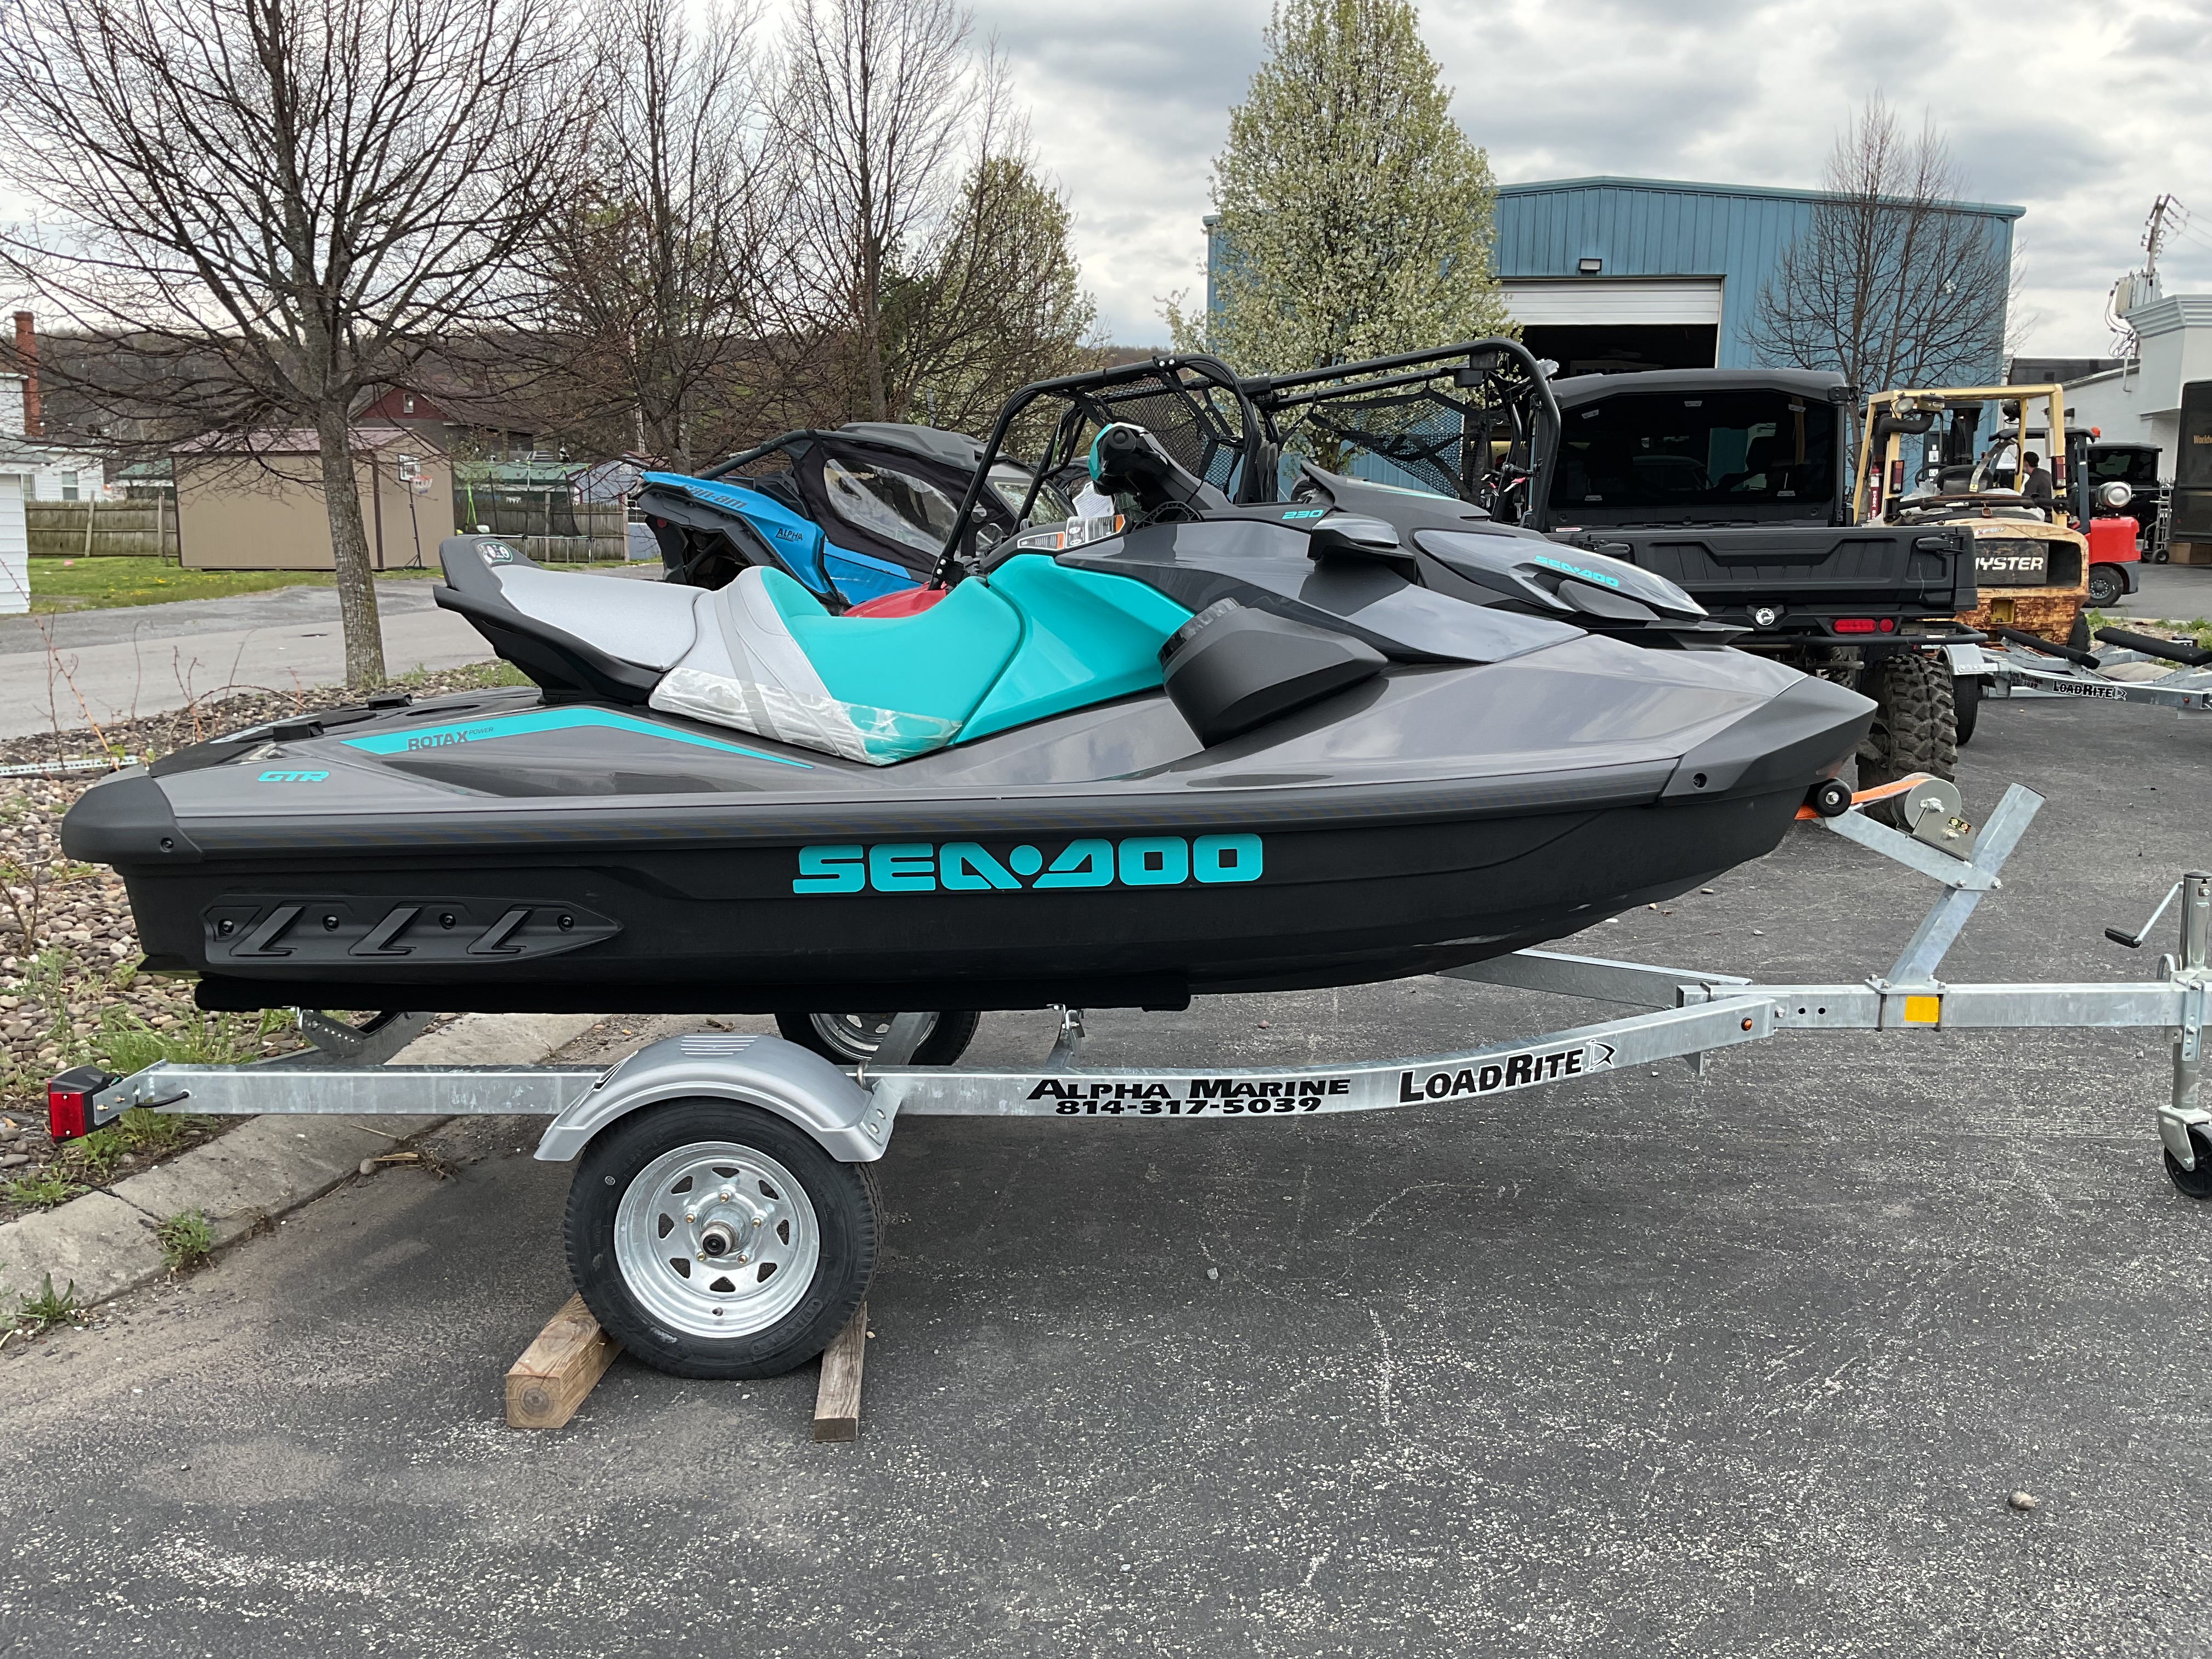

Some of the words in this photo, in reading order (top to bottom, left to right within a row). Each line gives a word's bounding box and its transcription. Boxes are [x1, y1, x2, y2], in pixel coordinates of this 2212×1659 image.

[1282, 510, 1323, 520] 230
[775, 528, 803, 541] ALPHA
[408, 730, 469, 751] ROTAX
[469, 727, 493, 735] POWER
[258, 771, 329, 781] GTR
[1399, 1048, 1585, 1104] LOADRITE
[1026, 1079, 1172, 1100] ALPHA
[1188, 1078, 1351, 1100] MARINE
[1056, 1097, 1322, 1115] 814-317-5039
